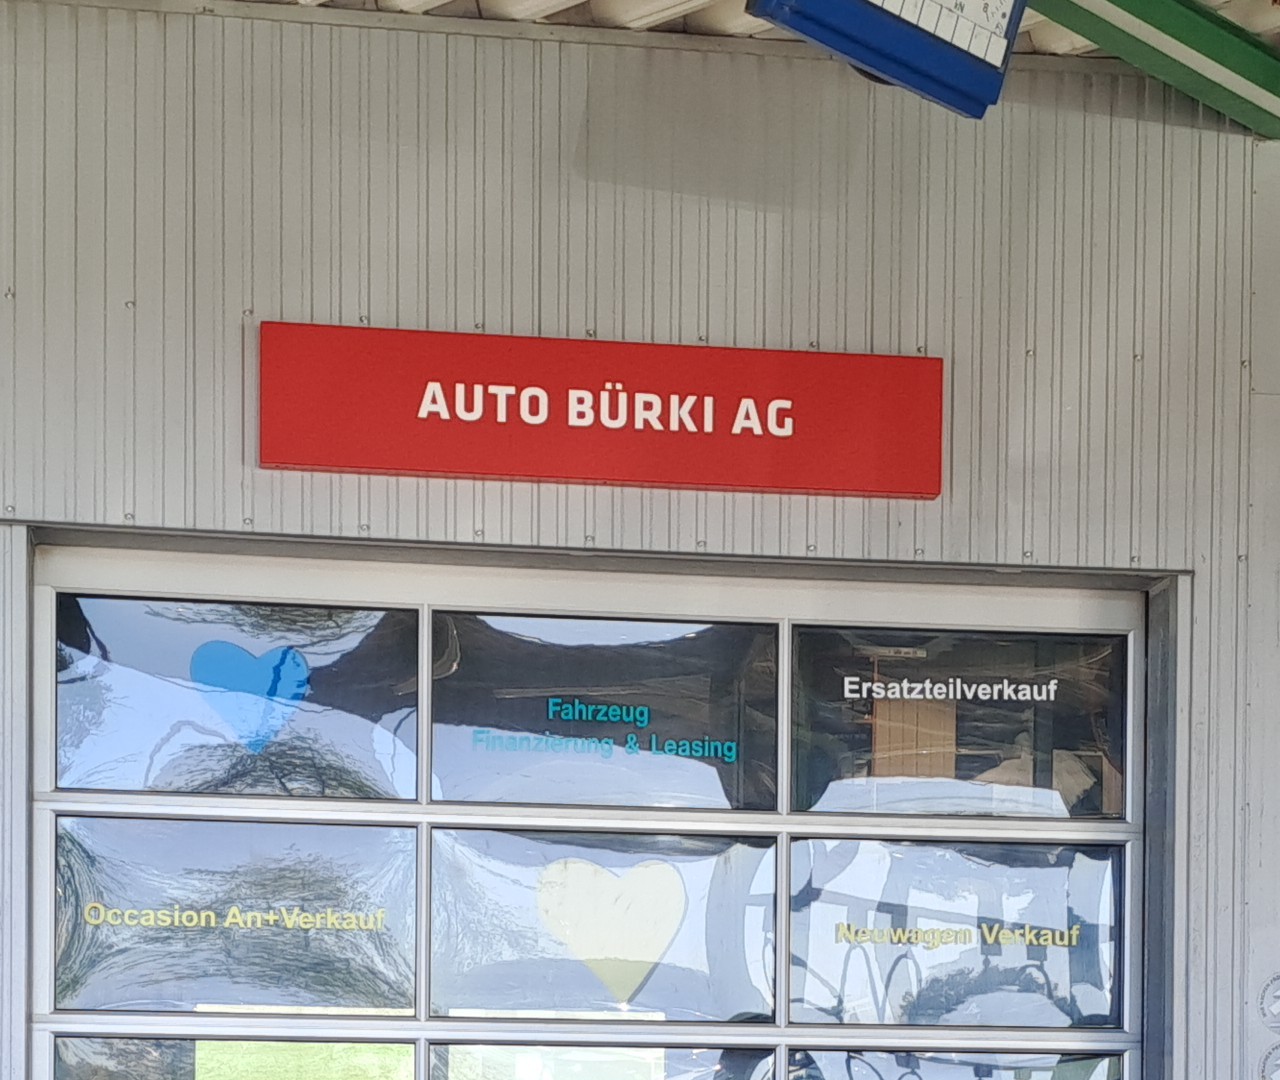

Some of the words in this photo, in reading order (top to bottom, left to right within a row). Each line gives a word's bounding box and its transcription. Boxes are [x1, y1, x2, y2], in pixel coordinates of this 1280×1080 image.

[417, 381, 549, 427] AUTO
[566, 381, 714, 434] BÜRKI
[731, 397, 794, 438] AG
[842, 676, 1058, 701] Ersatzteilverkauf
[546, 697, 651, 728] Fahrzeug
[471, 729, 616, 759] Finanzierung
[624, 733, 640, 755] &
[649, 733, 738, 763] Leasing
[83, 901, 216, 928] Occasion
[835, 921, 974, 950] Neuwagen
[981, 922, 1081, 947] Verkauf
